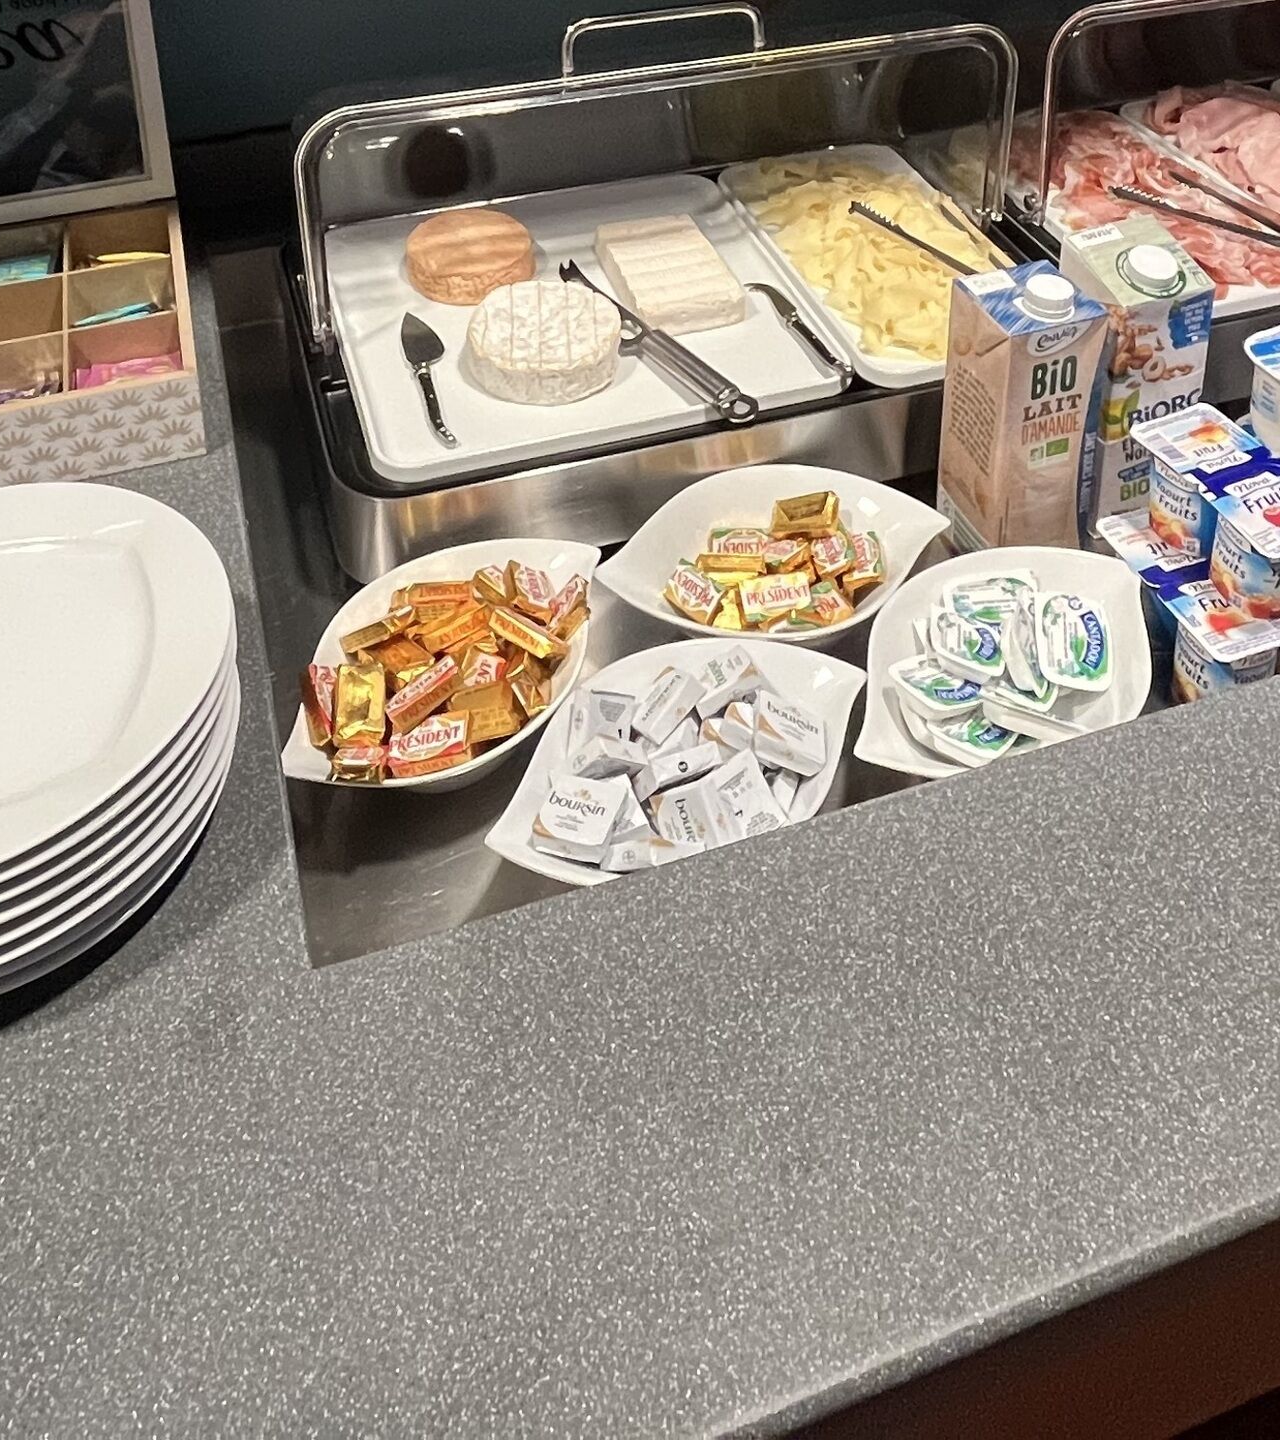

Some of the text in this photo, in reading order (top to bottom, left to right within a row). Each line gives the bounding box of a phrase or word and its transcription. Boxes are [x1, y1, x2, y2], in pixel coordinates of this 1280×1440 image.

[1022, 393, 1083, 422] LAIT
[1021, 412, 1081, 445] D'AMANDE
[1120, 480, 1150, 501] BIO
[1156, 479, 1192, 508] Yaourt
[1158, 495, 1198, 522] Fruits
[1198, 596, 1231, 612] Fru
[1082, 611, 1105, 670] CANTADOU
